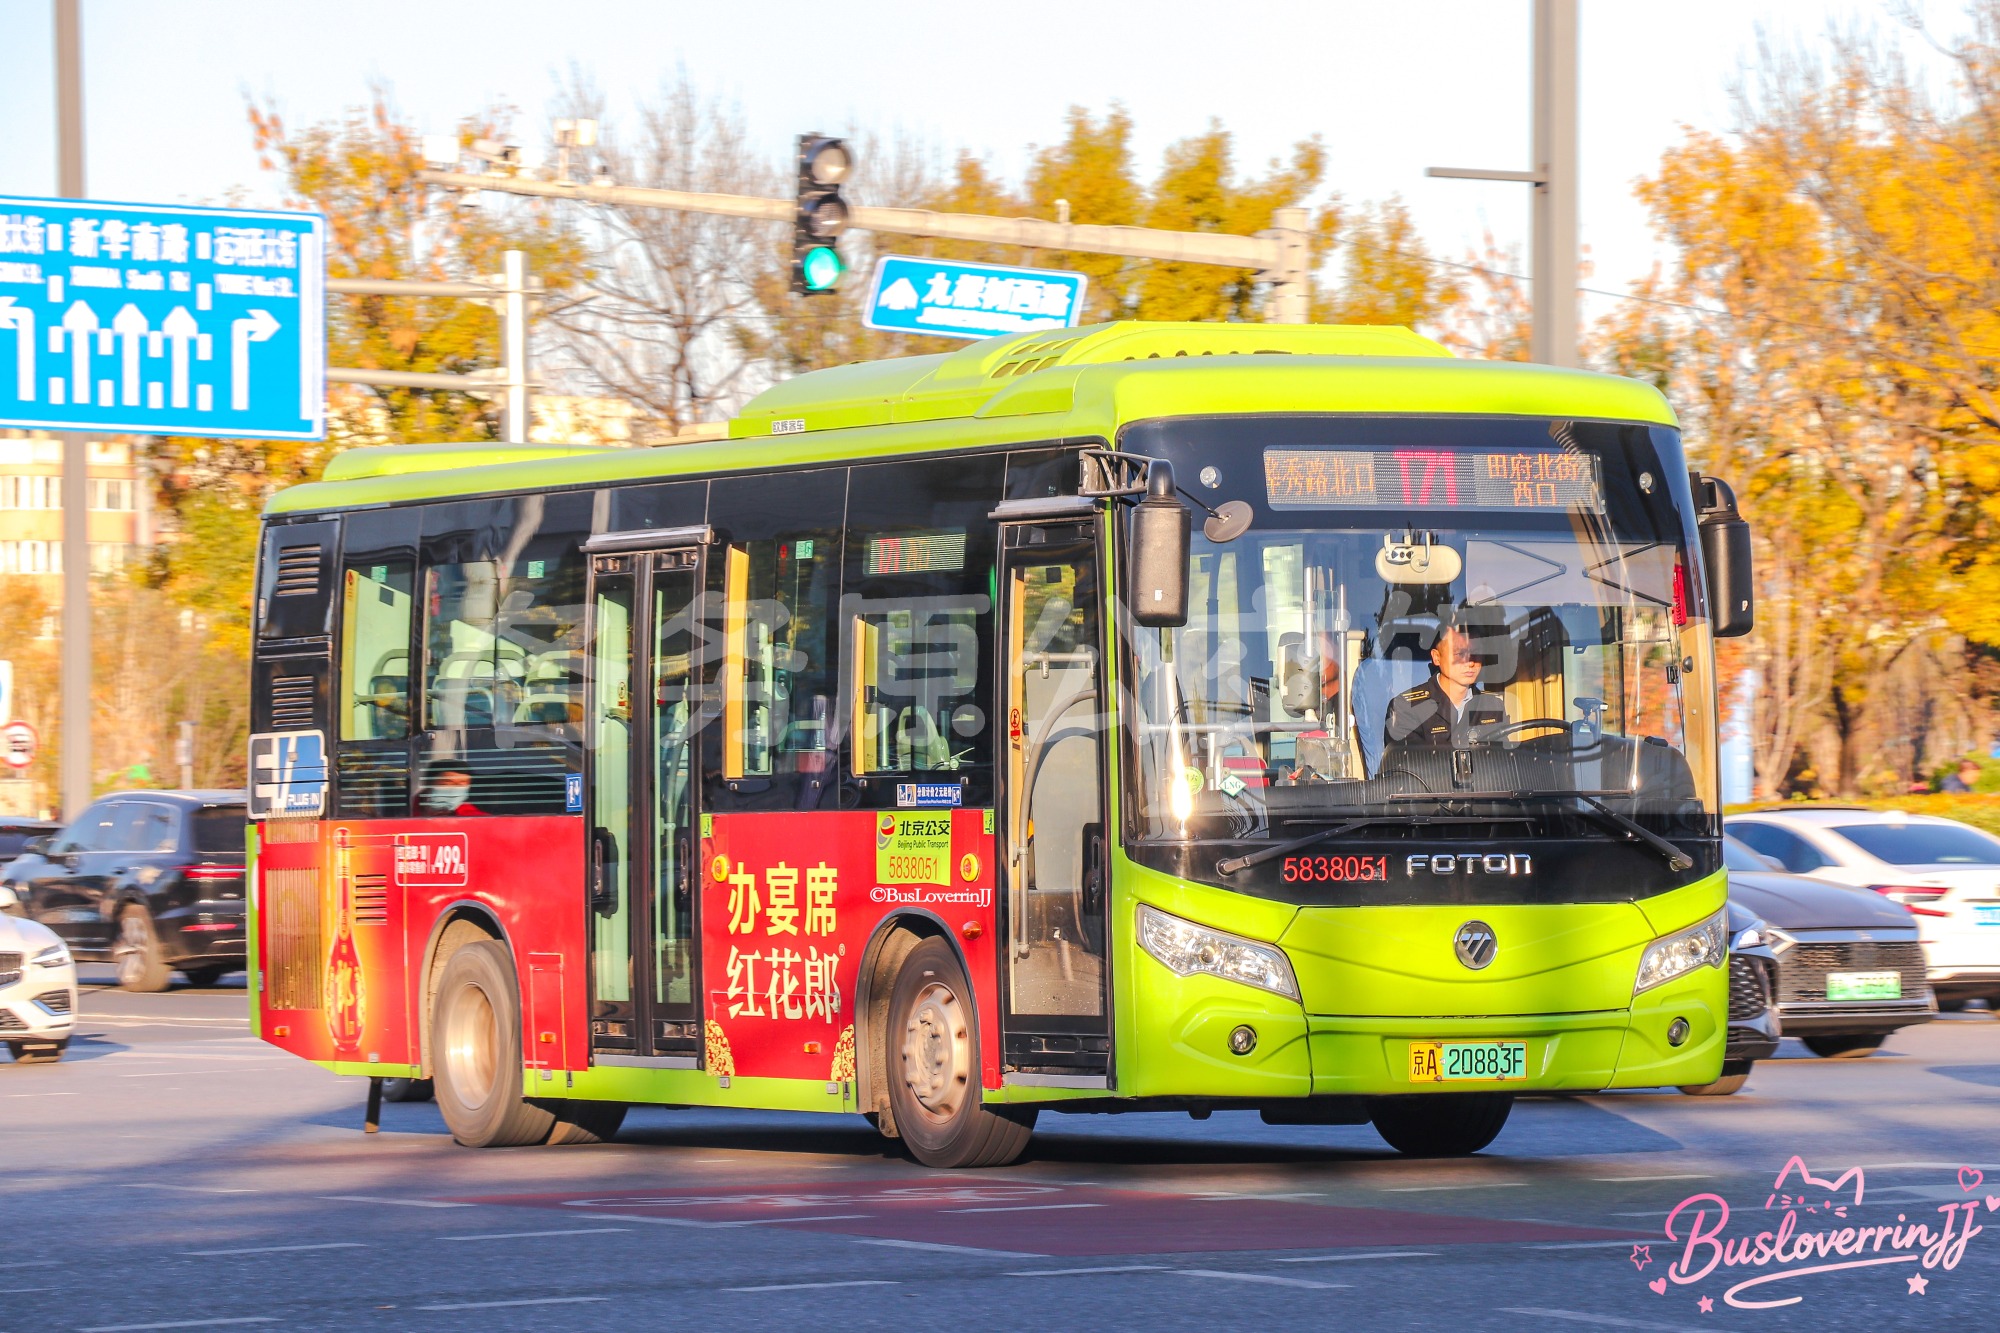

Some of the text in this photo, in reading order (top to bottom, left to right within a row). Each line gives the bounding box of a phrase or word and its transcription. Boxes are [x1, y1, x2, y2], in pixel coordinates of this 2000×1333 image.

[1487, 453, 1579, 481] 田府北街
[1509, 481, 1556, 507] 西口
[1223, 780, 1241, 790] LNG
[898, 820, 950, 836] 北京公交
[897, 839, 948, 850] Beijing Public Transport
[888, 855, 937, 880] 5838051
[1282, 856, 1386, 882] 5838051
[1405, 854, 1532, 877] FOTON
[727, 861, 838, 937] 办宴席
[726, 945, 840, 1023] 红花郎
